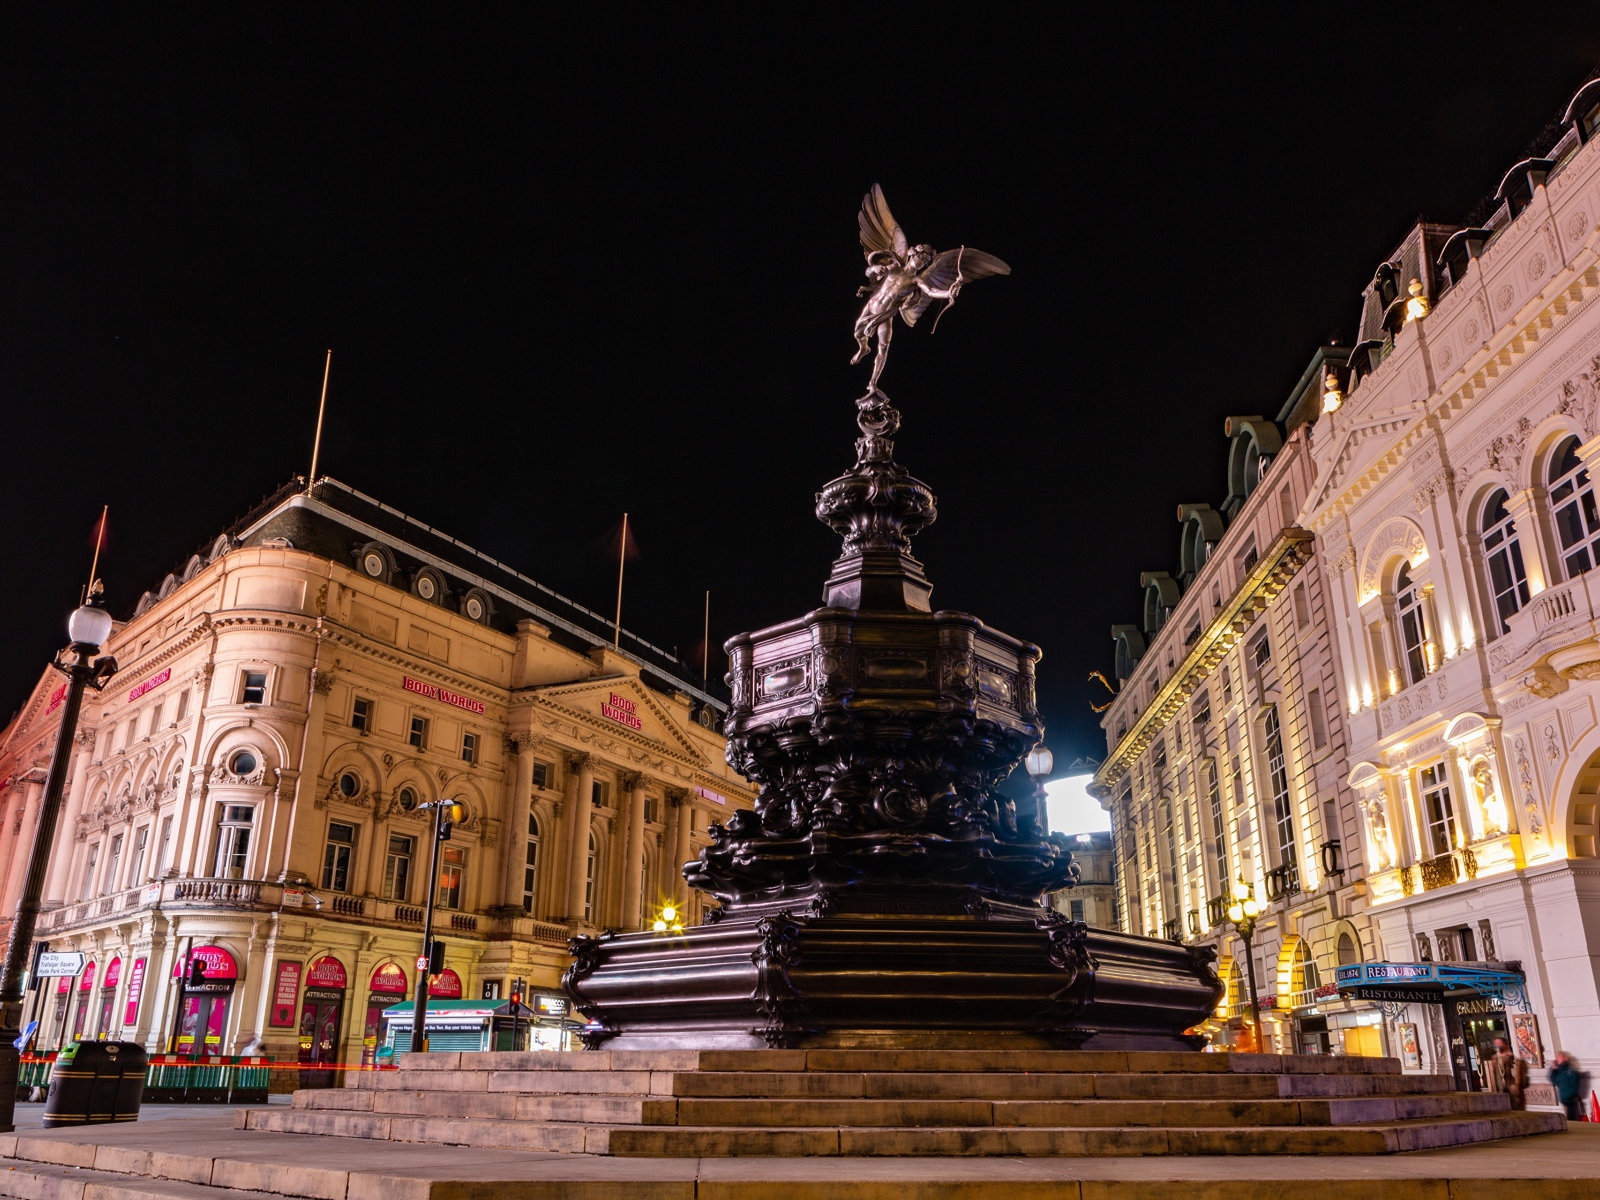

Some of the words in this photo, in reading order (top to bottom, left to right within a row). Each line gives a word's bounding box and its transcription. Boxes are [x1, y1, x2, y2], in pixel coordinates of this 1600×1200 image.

[403, 677, 439, 699] BODY
[439, 688, 486, 715] WORLDS
[610, 692, 638, 715] BODY
[601, 702, 642, 731] WORLDS
[317, 964, 339, 973] BODY
[1367, 967, 1428, 978] RESTAURANT
[311, 972, 343, 981] WORLDS
[375, 977, 404, 986] WORLDS
[306, 991, 341, 999] ATTRACTION
[370, 995, 402, 1003] ATTRACTION
[1361, 989, 1441, 1001] RISTORANTE
[1524, 1089, 1552, 1099] RANAIO
